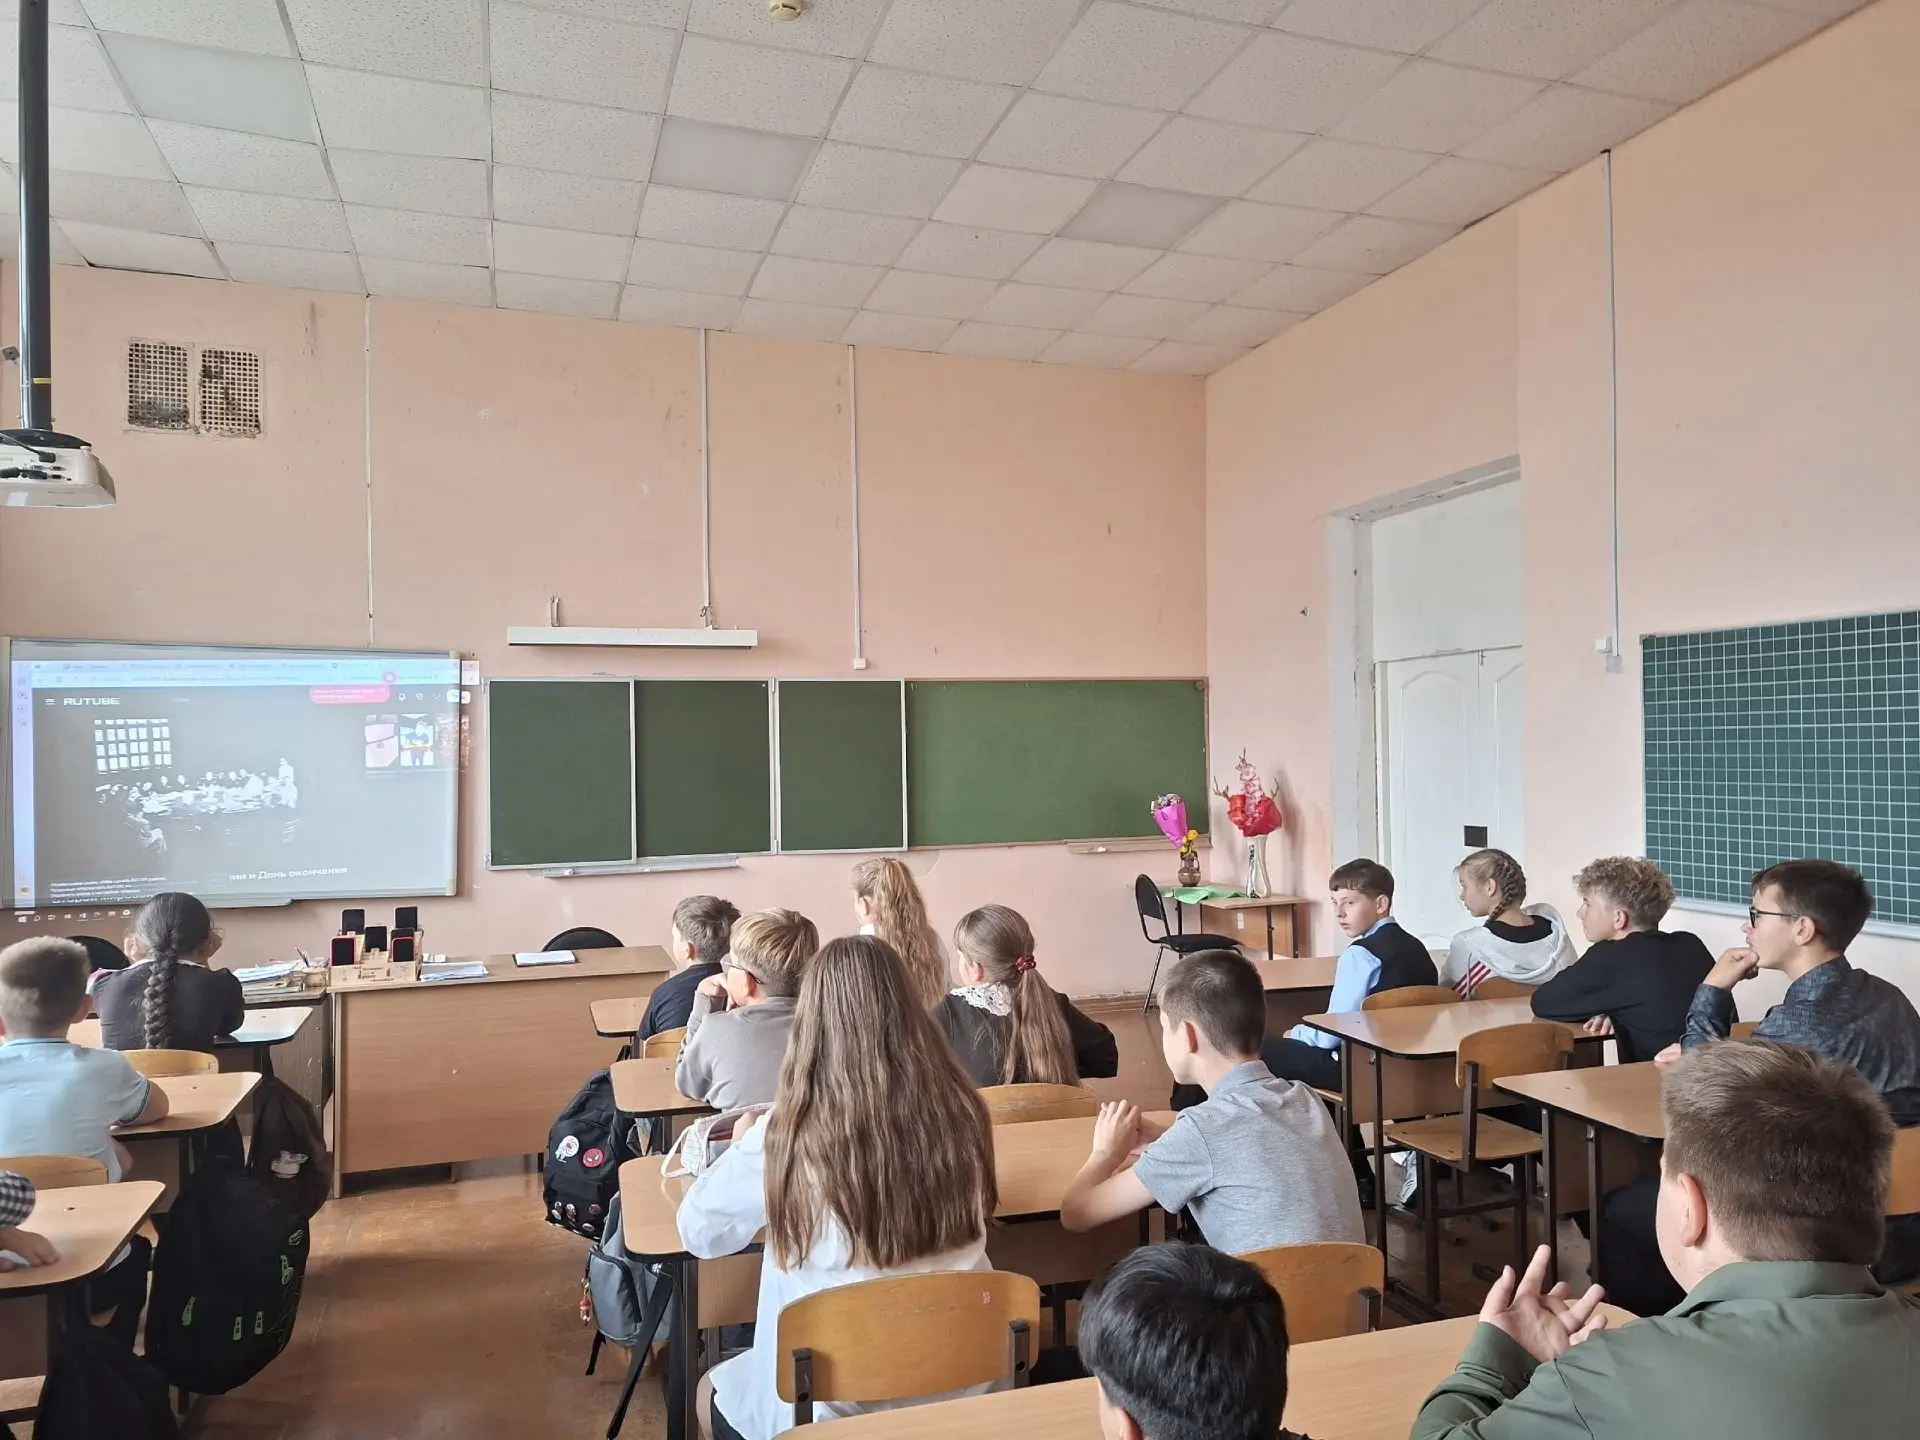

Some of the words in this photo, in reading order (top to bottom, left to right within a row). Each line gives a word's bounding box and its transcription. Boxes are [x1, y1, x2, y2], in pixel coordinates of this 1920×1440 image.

[63, 697, 120, 706] RUTUBE
[257, 870, 287, 881] День
[288, 867, 348, 878] окончания
